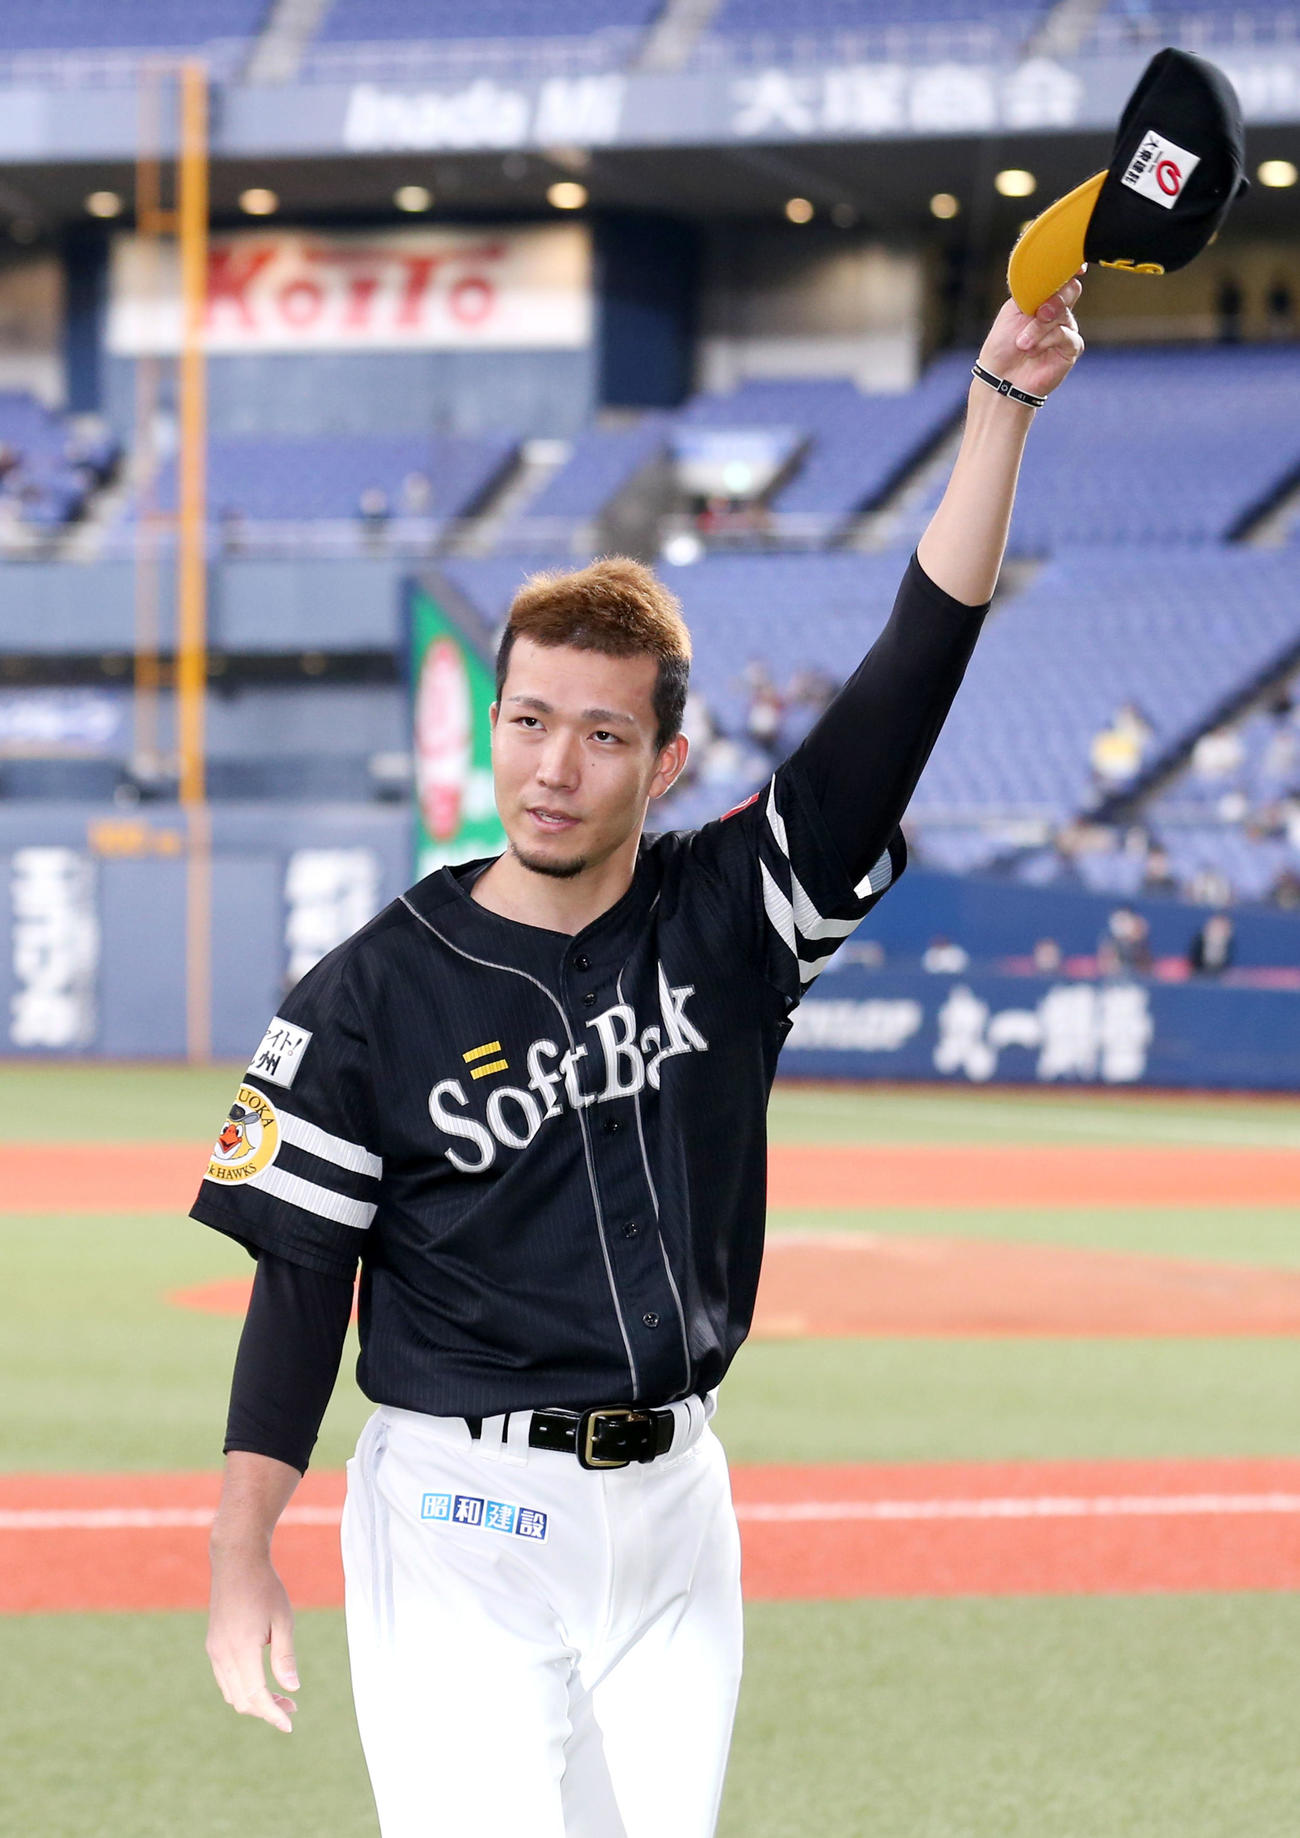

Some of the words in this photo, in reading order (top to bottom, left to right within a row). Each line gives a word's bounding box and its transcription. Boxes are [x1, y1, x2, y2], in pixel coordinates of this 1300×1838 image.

[265, 1029, 303, 1057] イト!
[250, 1049, 281, 1076] 州
[428, 958, 709, 1174] SoftBak
[216, 1162, 258, 1180] HAWKS
[423, 1494, 546, 1539] 昭和建設
